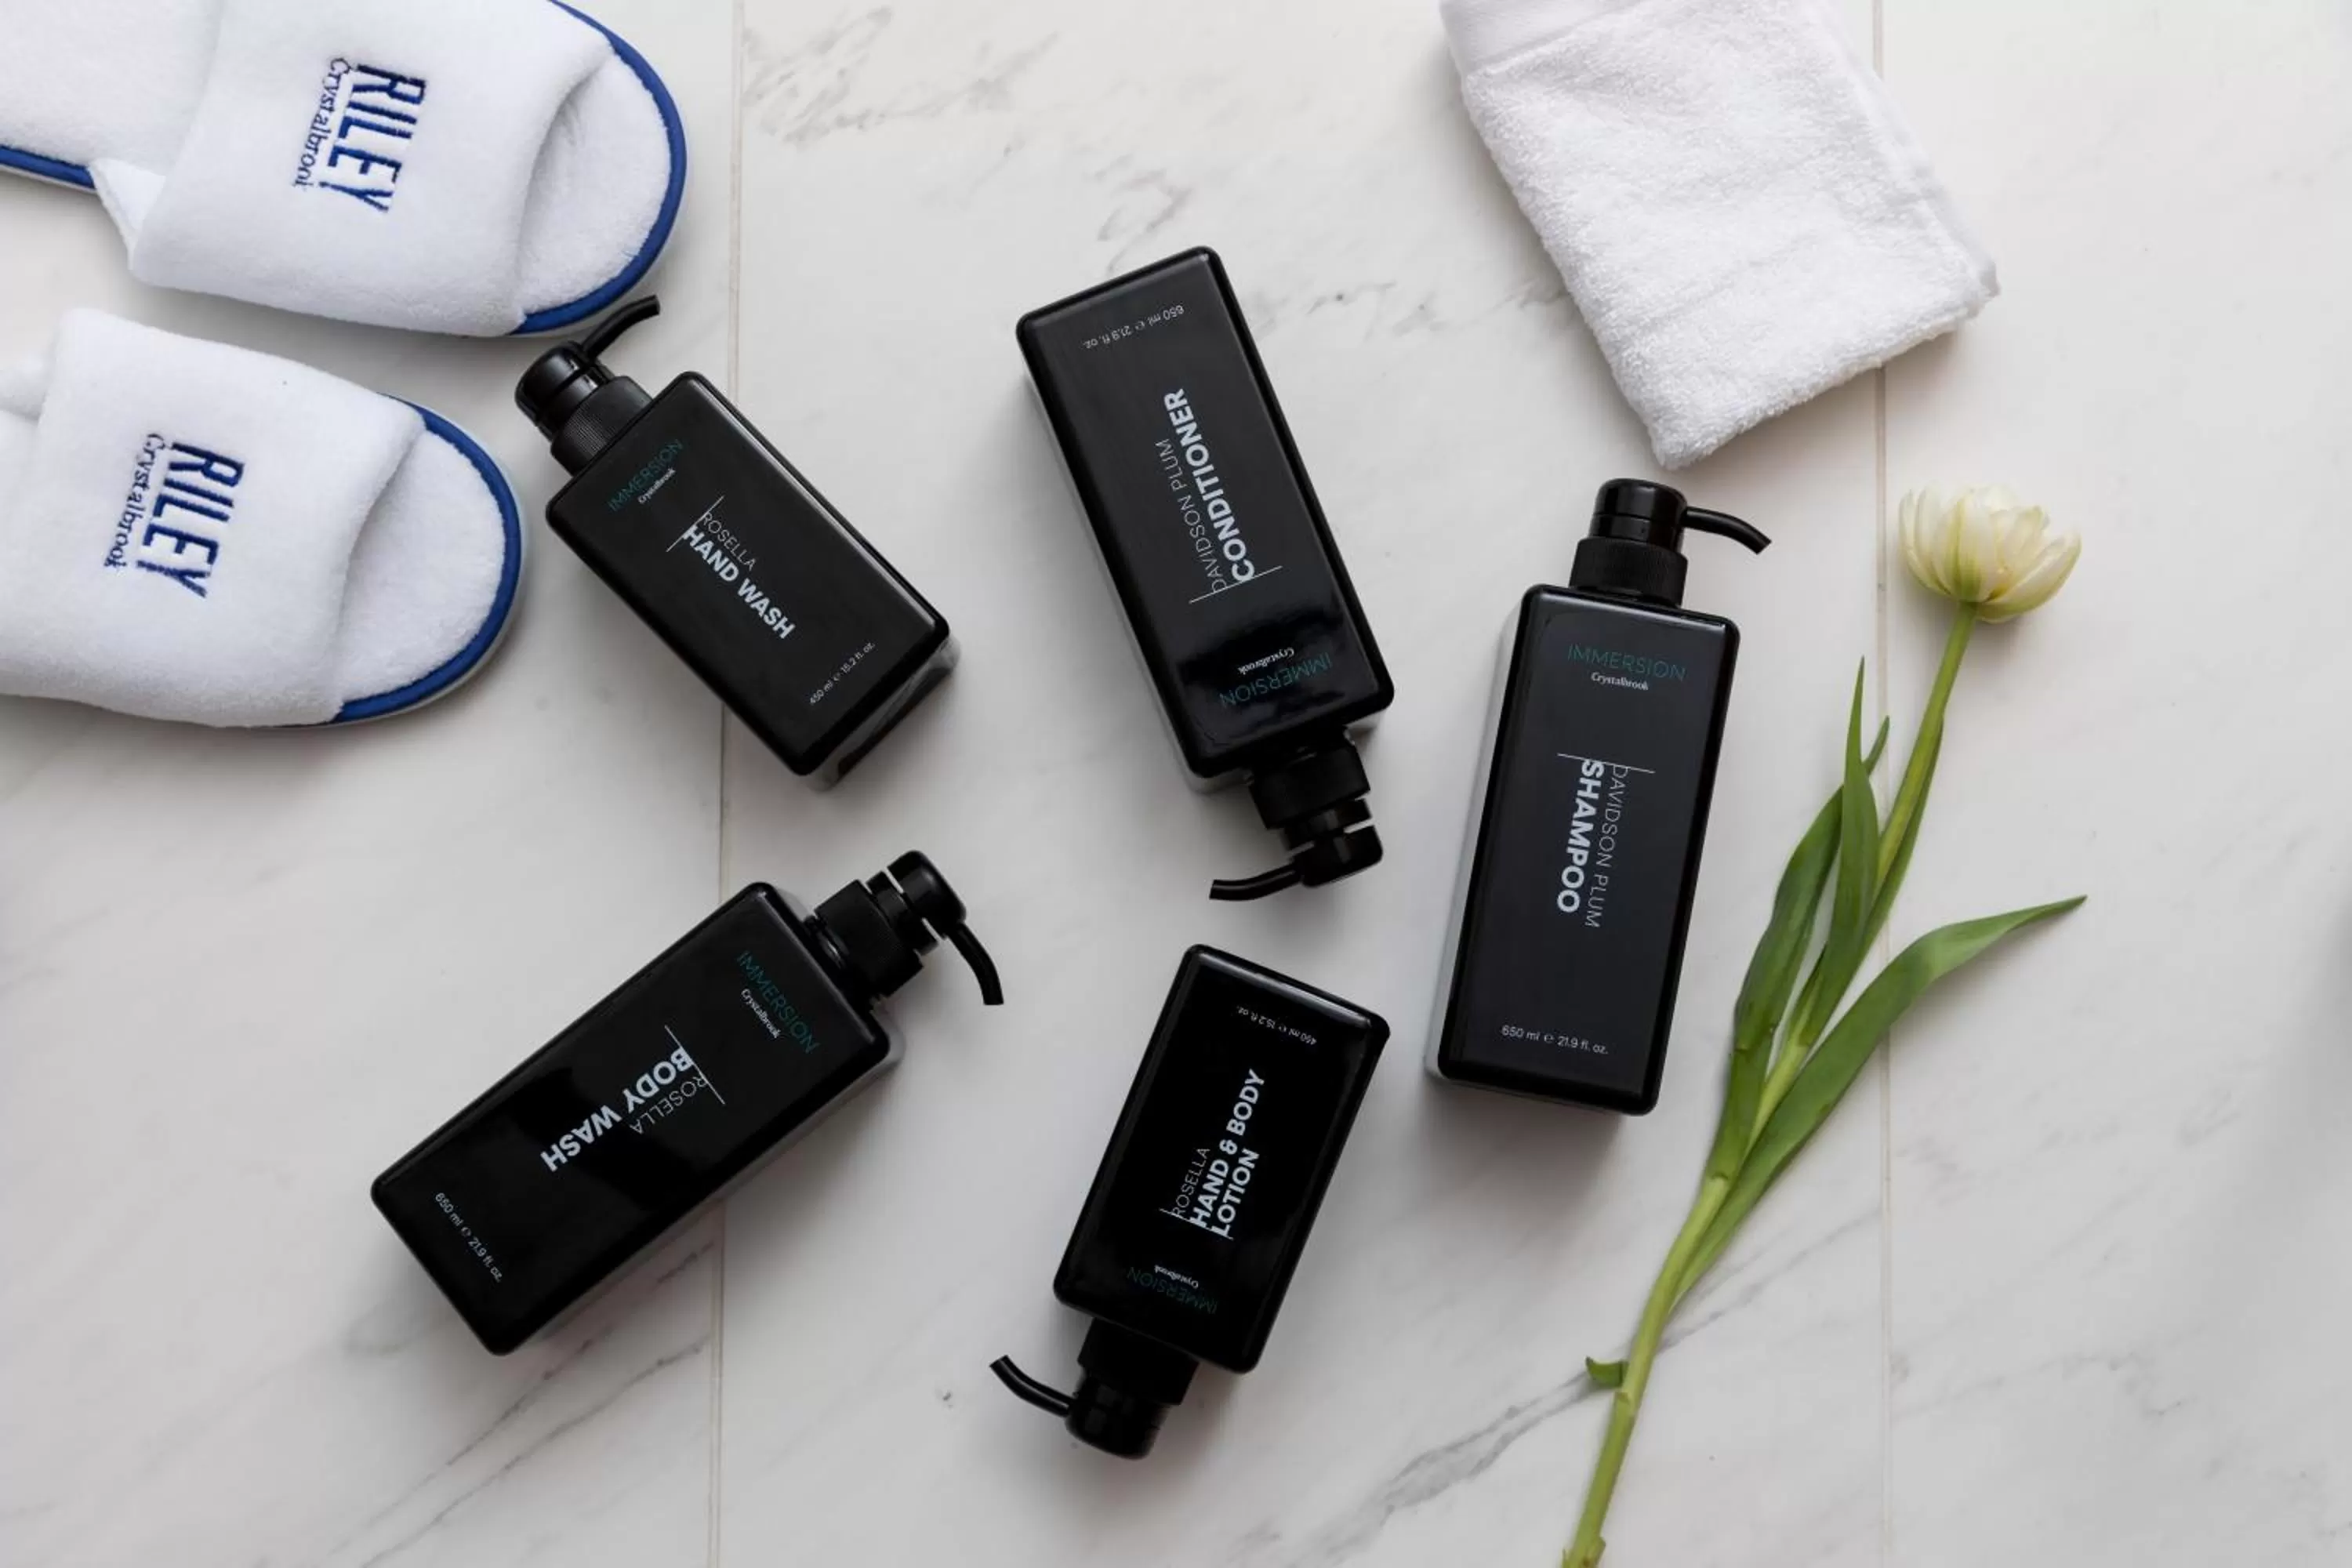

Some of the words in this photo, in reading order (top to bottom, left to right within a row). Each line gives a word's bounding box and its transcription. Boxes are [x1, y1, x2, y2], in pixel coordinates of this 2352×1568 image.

[318, 64, 426, 212] RILEY
[1111, 325, 1131, 340] 21.9
[1147, 314, 1161, 326] ml
[1163, 305, 1184, 320] 650
[608, 439, 683, 511] IMMERSION
[1155, 438, 1187, 492] PLUM
[1163, 388, 1254, 582] CONDITIONER
[103, 434, 165, 568] Crystalbrook
[136, 442, 245, 598] RILEY
[704, 511, 757, 572] ROSELLA
[1177, 495, 1227, 593] DAVIDSON
[682, 524, 739, 582] HAND
[738, 578, 796, 639] WASH
[1218, 652, 1330, 708] IMMERSION
[1567, 643, 1686, 682] IMMERSION
[1557, 760, 1605, 913] SHAMPOO
[1595, 764, 1629, 868] DAVIDSON
[1584, 874, 1609, 928] PLUM
[738, 950, 820, 1054] IMMERSION
[1501, 1025, 1524, 1038] 650
[1526, 1031, 1541, 1041] ml
[1557, 1036, 1578, 1048] 21.9
[622, 1047, 695, 1114] BODY
[630, 1076, 708, 1134] ROSELLA
[1226, 1069, 1265, 1136] BODY
[540, 1105, 622, 1172] WASH
[1219, 1139, 1238, 1155] &
[435, 1192, 454, 1214] 650
[1171, 1148, 1210, 1217] ROSELLA
[1189, 1159, 1229, 1228] HAND
[1210, 1147, 1260, 1237] LOTION
[1127, 1266, 1218, 1315] IMMERSION
